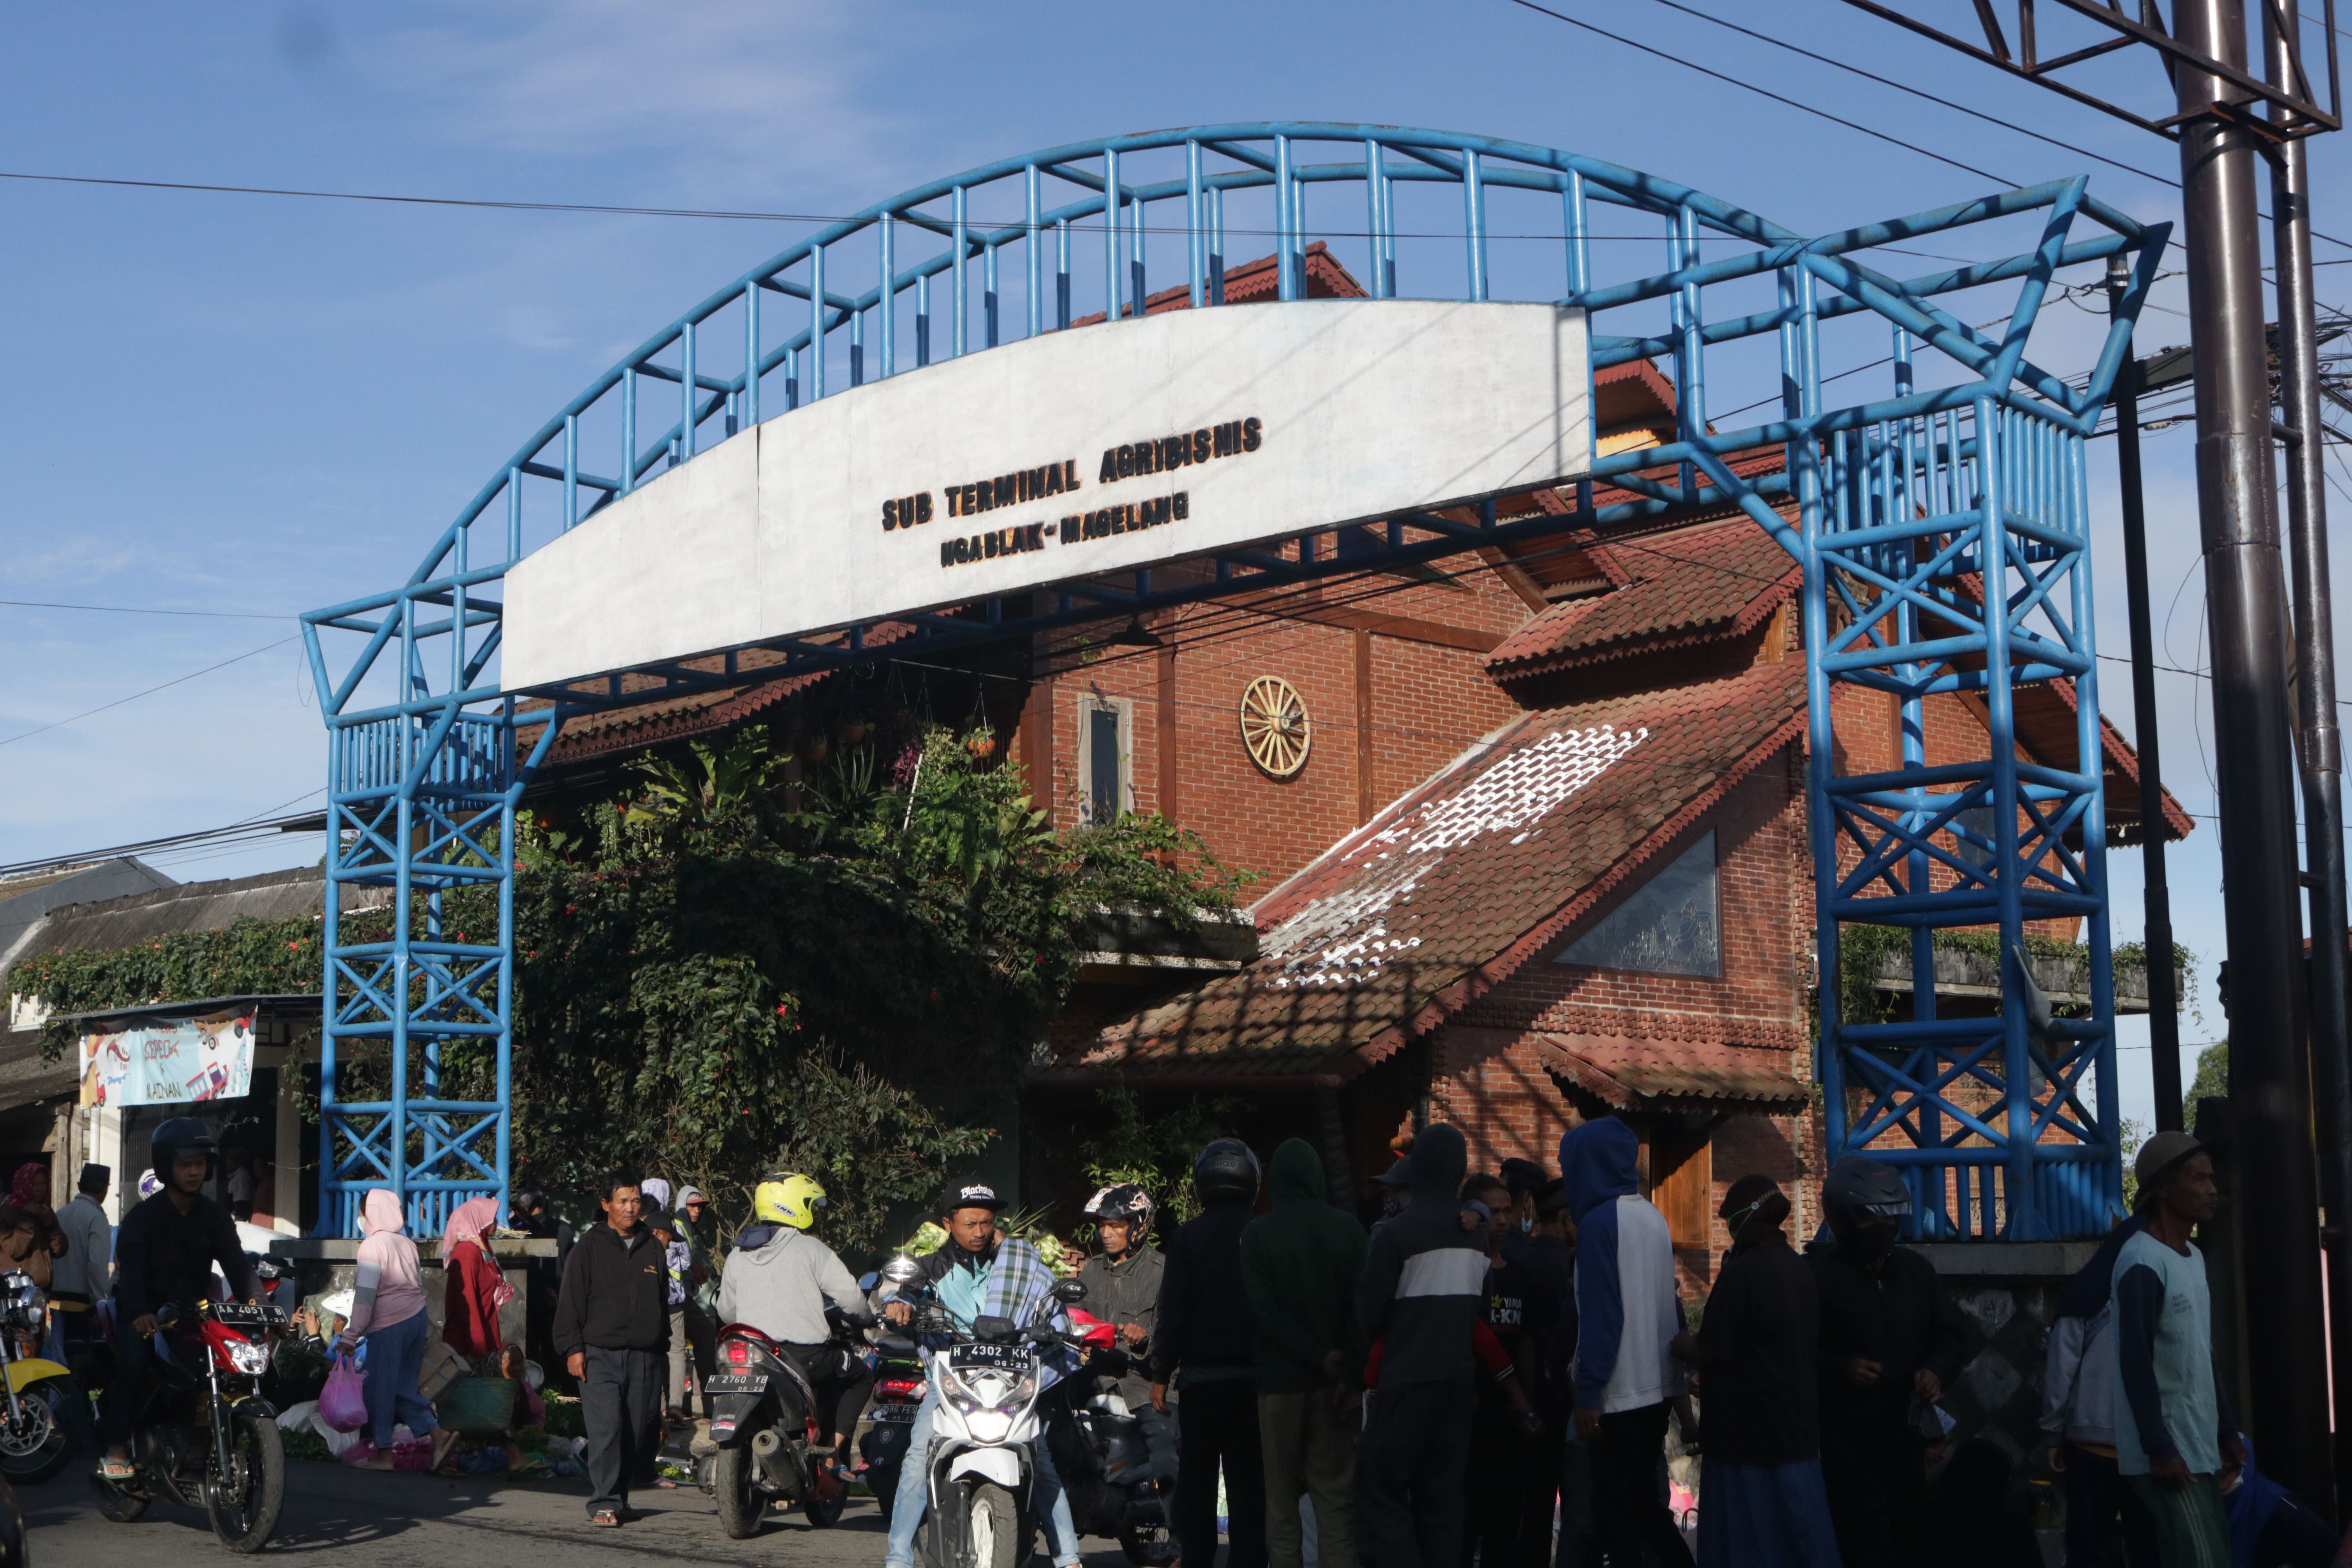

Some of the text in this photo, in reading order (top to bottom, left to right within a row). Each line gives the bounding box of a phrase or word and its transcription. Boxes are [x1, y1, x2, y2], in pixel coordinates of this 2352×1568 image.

[882, 417, 1262, 530] SUB TERMINAL AGRIBISNIS
[145, 1040, 180, 1062] SEPEDA
[160, 1063, 165, 1075] &
[147, 1081, 181, 1100] MAINAN
[777, 1205, 793, 1214] INK
[239, 1306, 263, 1314] 4057
[953, 1346, 1028, 1359] H 4302 KK
